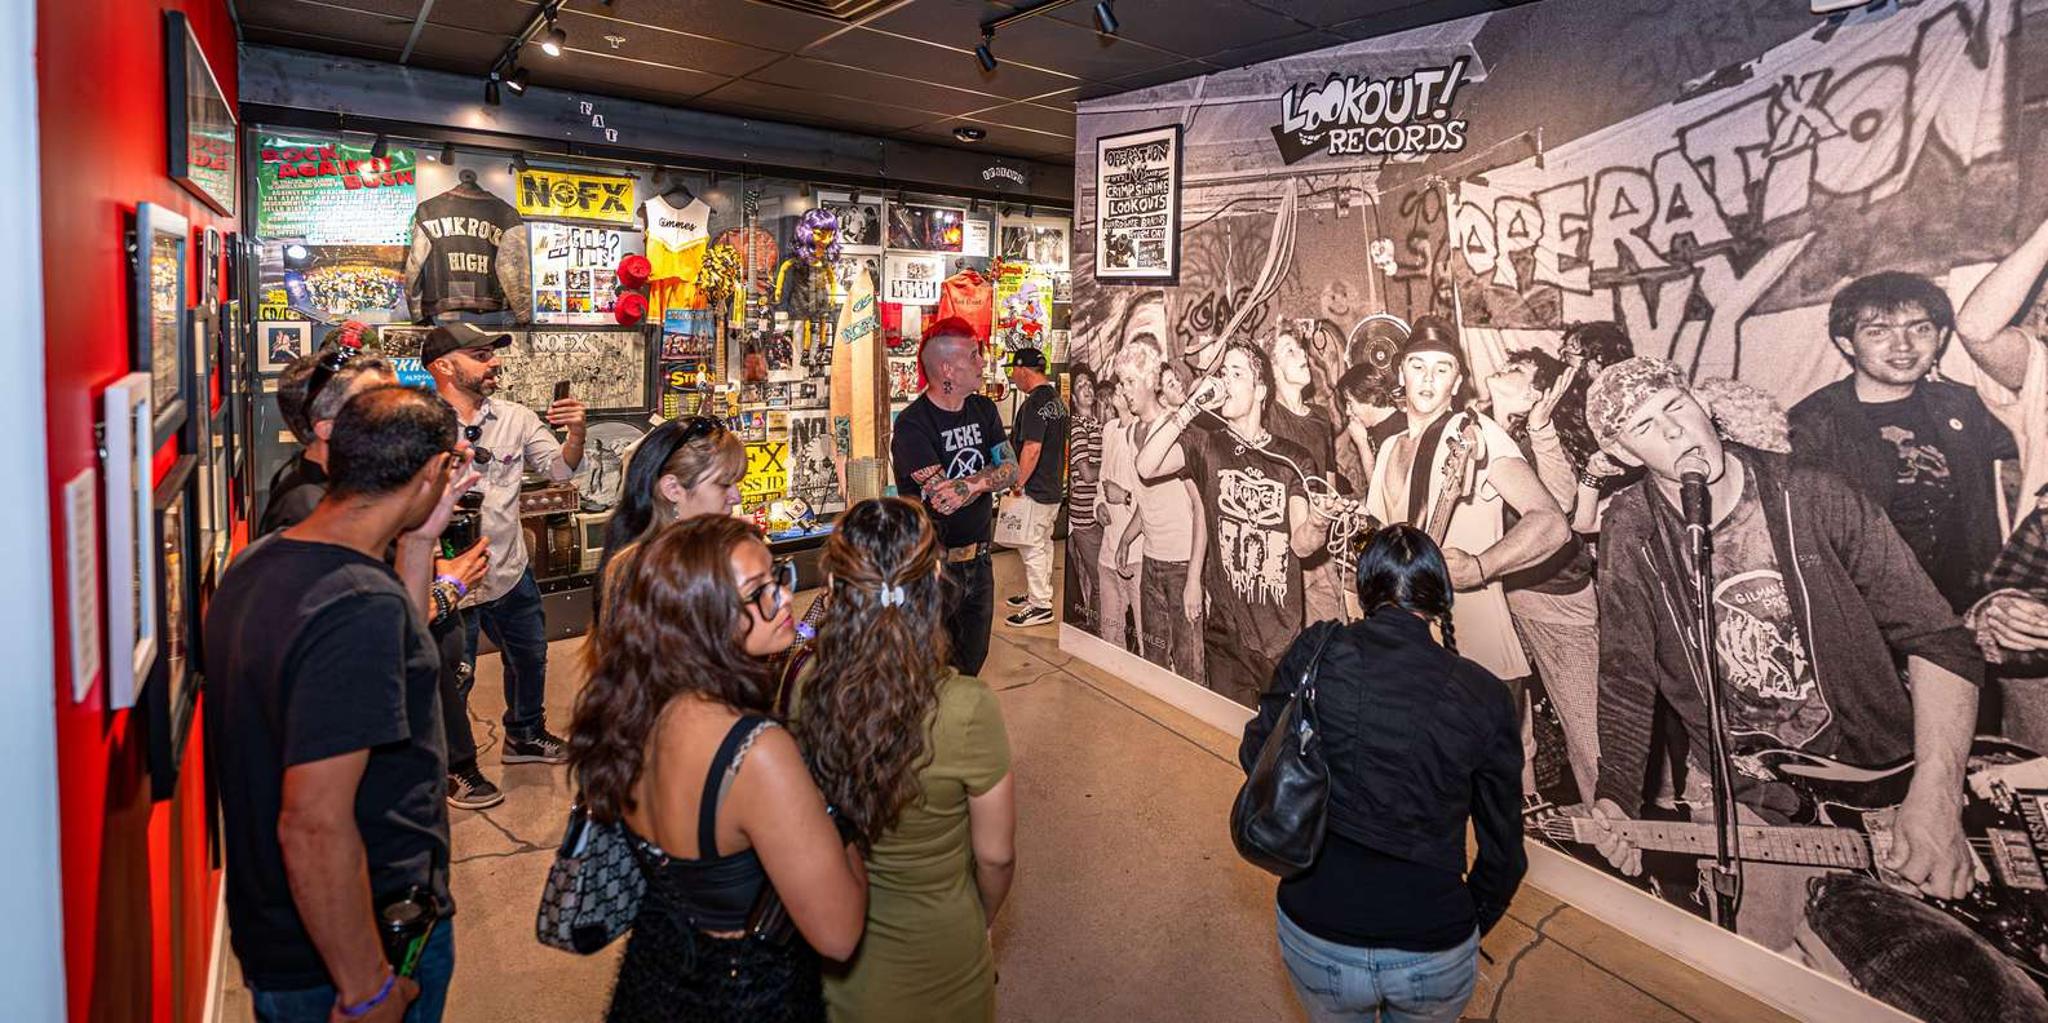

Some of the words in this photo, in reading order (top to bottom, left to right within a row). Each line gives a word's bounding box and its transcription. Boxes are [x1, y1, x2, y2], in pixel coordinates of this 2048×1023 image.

[1281, 58, 1468, 134] LOOKOUT!
[1328, 120, 1467, 154] RECORDS
[1450, 0, 2020, 293] OPERATION
[1107, 142, 1169, 167] OPERATION
[343, 171, 414, 190] BUSH
[522, 176, 630, 213] NOFX
[1110, 195, 1165, 214] LOOKOUTS
[447, 252, 488, 274] HIGH
[532, 332, 591, 352] NOFX
[941, 423, 983, 452] ZEKE
[1735, 584, 1778, 604] GILMAN
